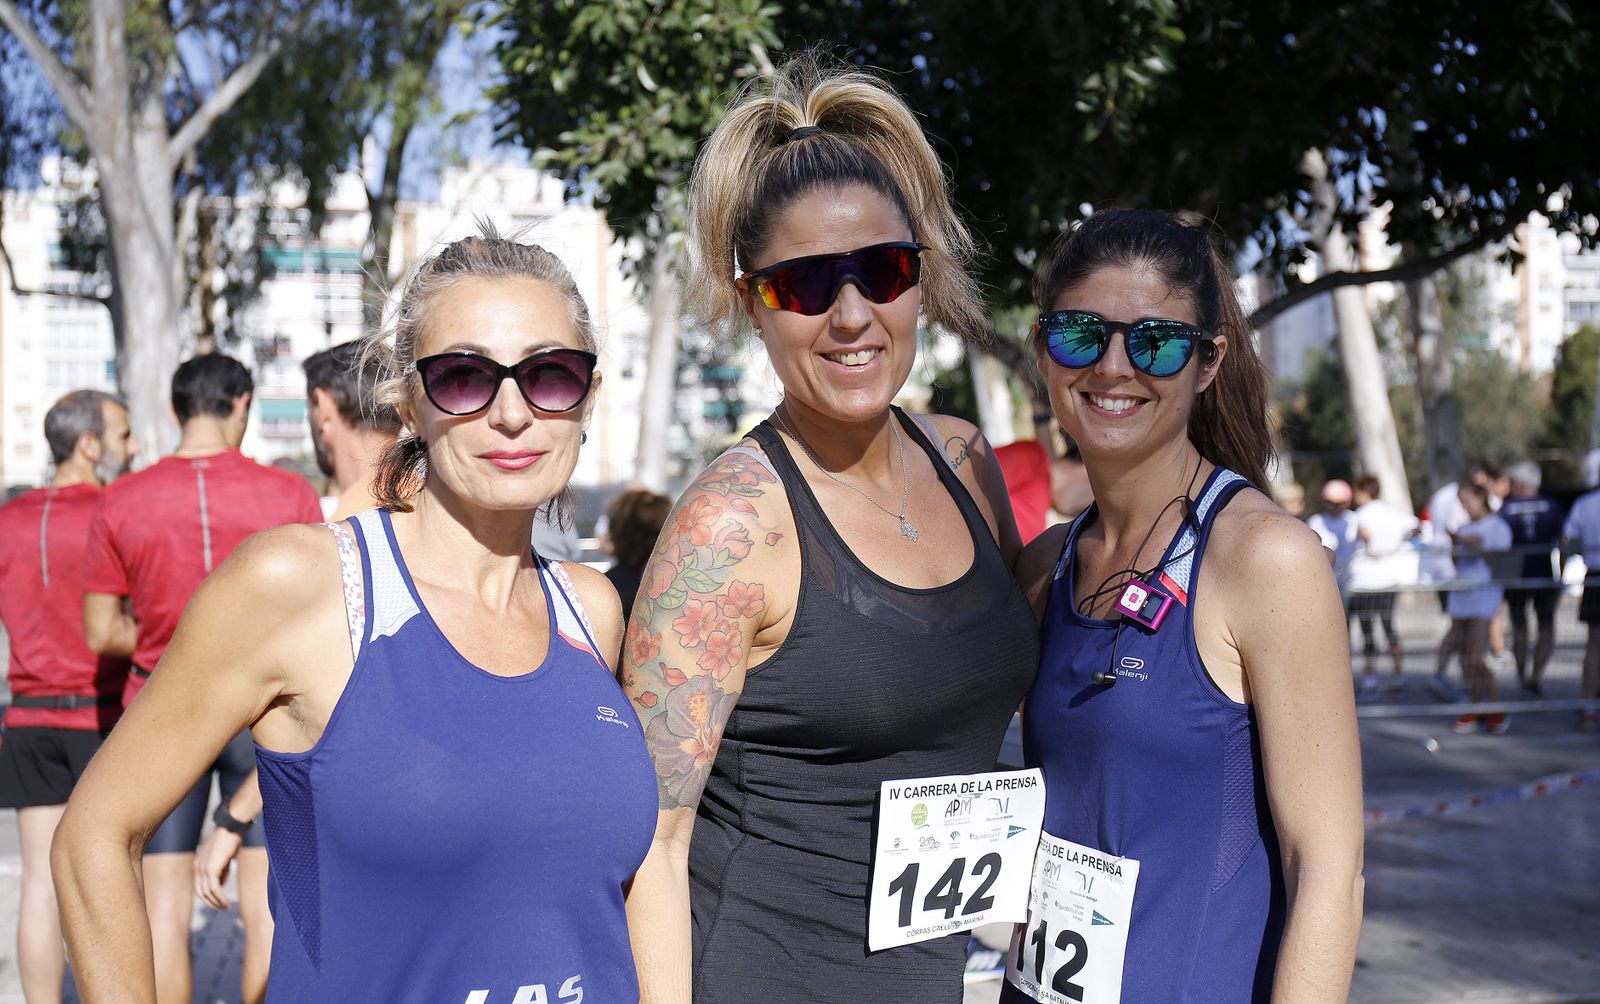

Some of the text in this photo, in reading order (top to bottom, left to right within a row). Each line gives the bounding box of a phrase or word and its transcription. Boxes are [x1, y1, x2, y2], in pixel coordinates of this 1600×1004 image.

[889, 776, 1038, 800] IV CARRERA DE LA PRENSA
[1052, 844, 1064, 859] DE
[1067, 849, 1079, 864] LA
[1081, 854, 1123, 878] PRENSA
[888, 852, 1002, 928] 142
[906, 927, 931, 938] CORPAS
[1016, 909, 1088, 1002] 112
